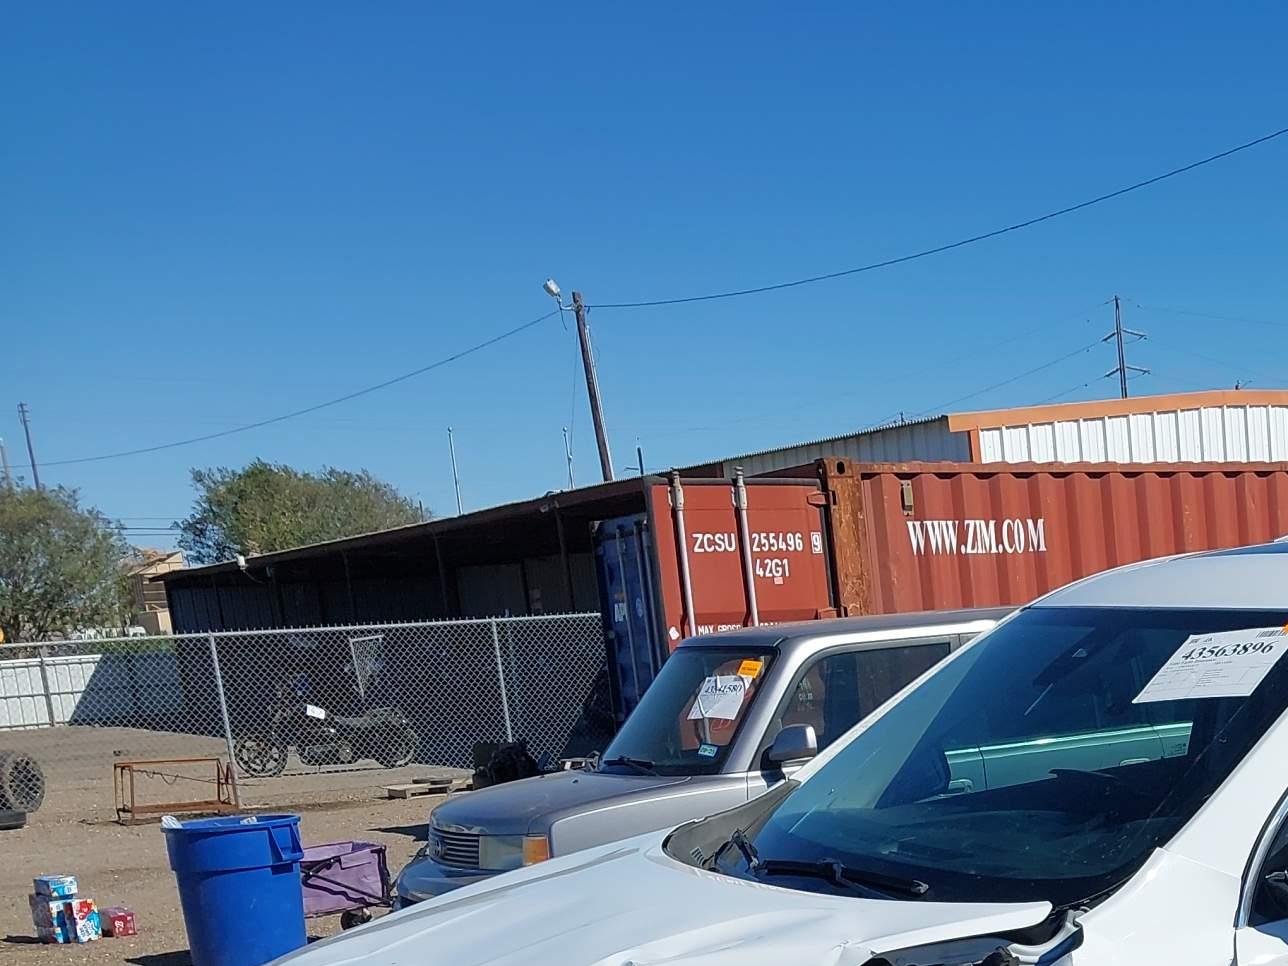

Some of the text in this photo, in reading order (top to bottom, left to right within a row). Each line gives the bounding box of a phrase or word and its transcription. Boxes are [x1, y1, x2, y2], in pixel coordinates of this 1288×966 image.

[692, 533, 736, 553] ZCSU
[751, 532, 804, 552] 255496
[755, 558, 790, 577] 42G1
[1182, 641, 1278, 660] 43563896
